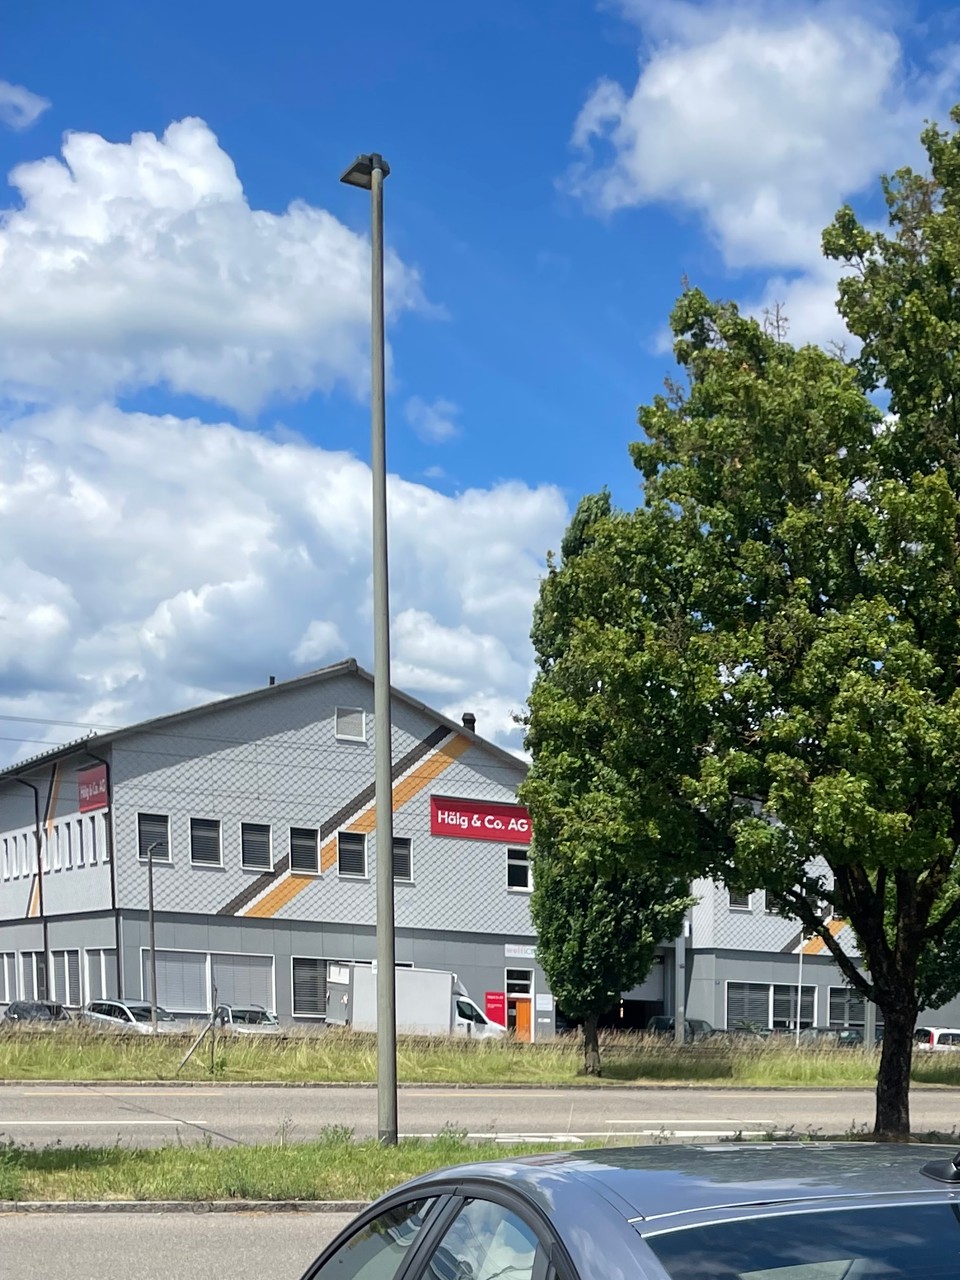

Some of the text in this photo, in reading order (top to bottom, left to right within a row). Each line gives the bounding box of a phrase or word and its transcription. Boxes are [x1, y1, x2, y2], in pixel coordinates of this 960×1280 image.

[437, 810, 529, 832] Hälg & Co. AG
